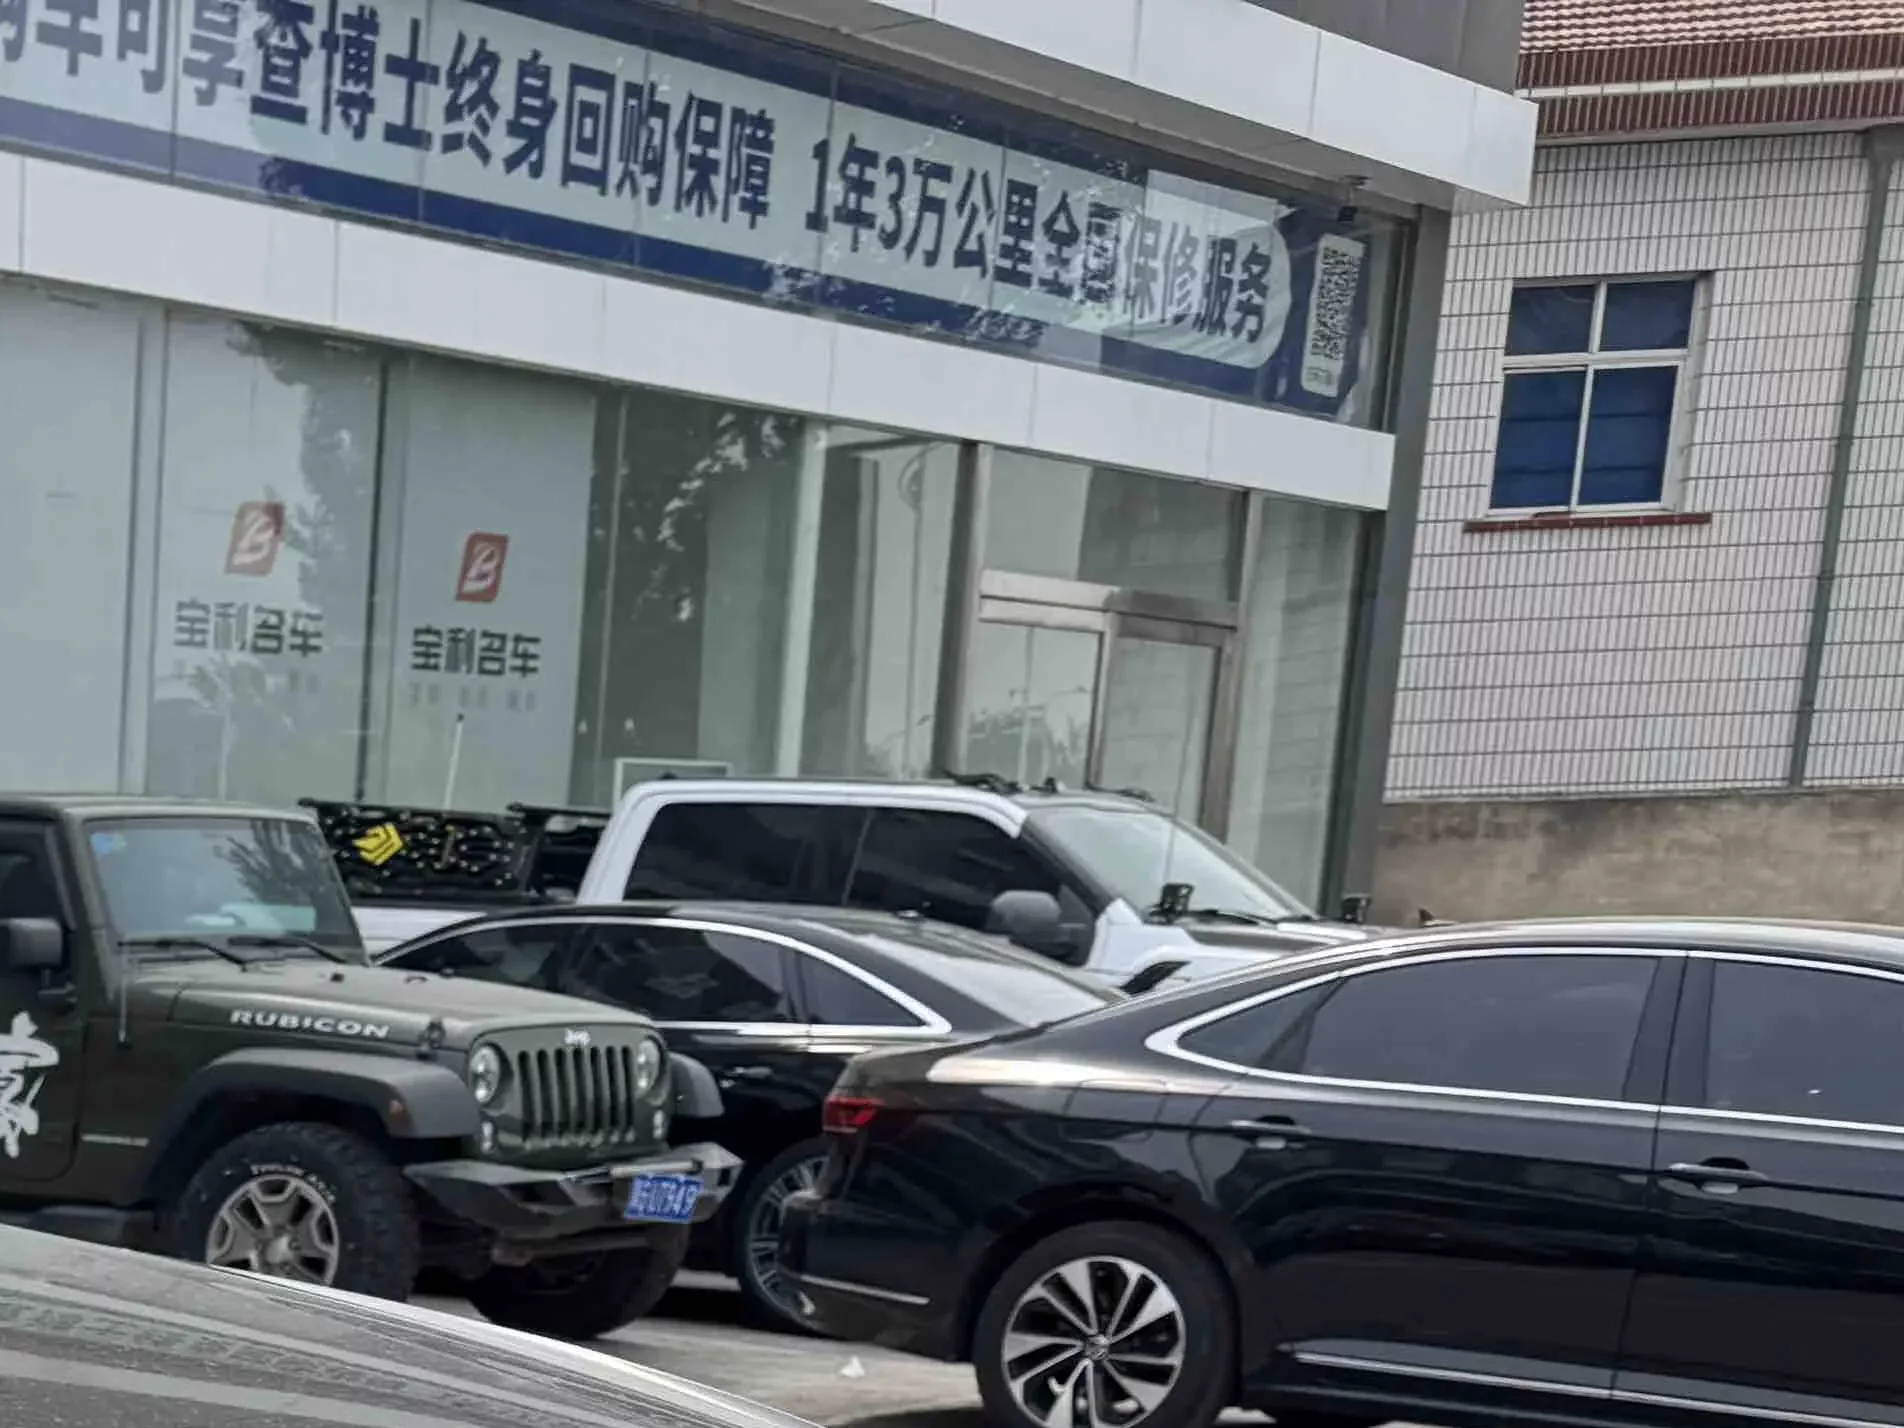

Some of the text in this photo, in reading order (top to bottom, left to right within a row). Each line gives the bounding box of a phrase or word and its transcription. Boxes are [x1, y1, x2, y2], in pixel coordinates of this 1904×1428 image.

[410, 623, 542, 678] 宝利名车
[229, 1008, 390, 1039] RUBICON
